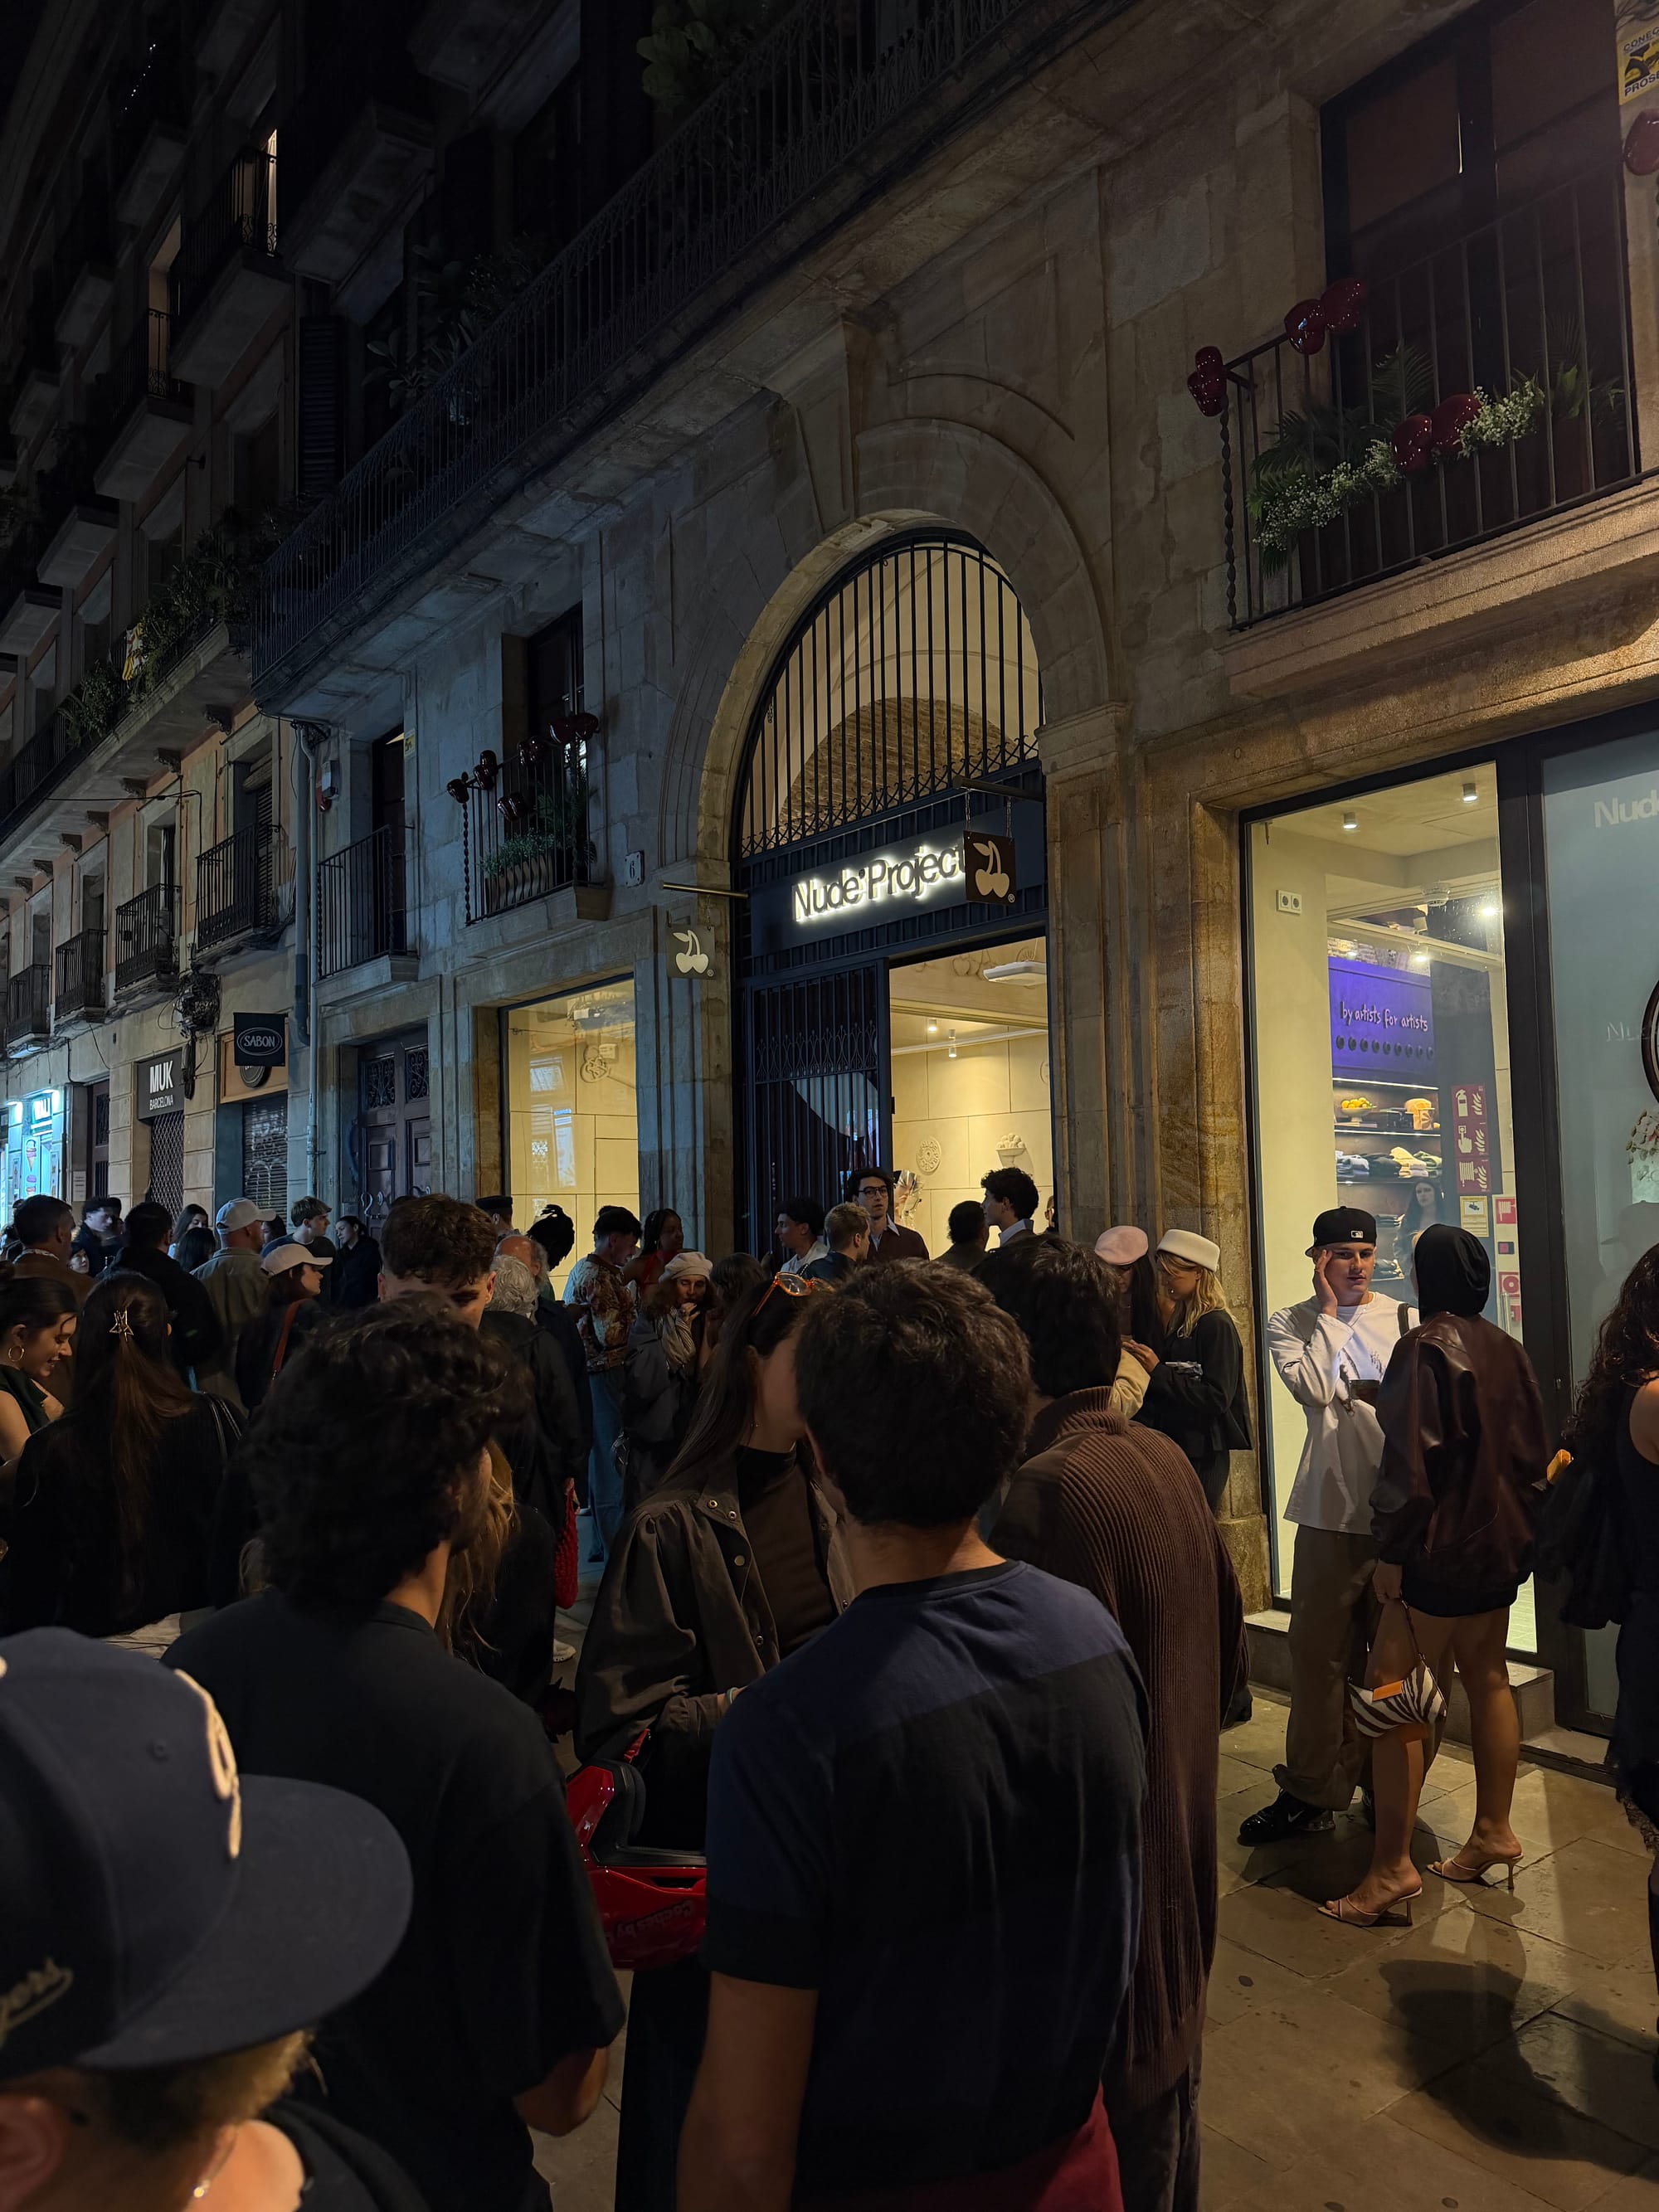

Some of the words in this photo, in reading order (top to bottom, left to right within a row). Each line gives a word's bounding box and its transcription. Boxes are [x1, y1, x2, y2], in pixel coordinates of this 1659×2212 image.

[1594, 790, 1659, 828] Nud
[1342, 1001, 1353, 1026] by
[1355, 1004, 1381, 1023] artists
[1384, 1009, 1398, 1028] for
[1401, 1014, 1428, 1032] artists
[244, 1036, 275, 1048] SABON
[149, 1060, 173, 1093] MUK
[149, 1095, 174, 1111] BARCELONA
